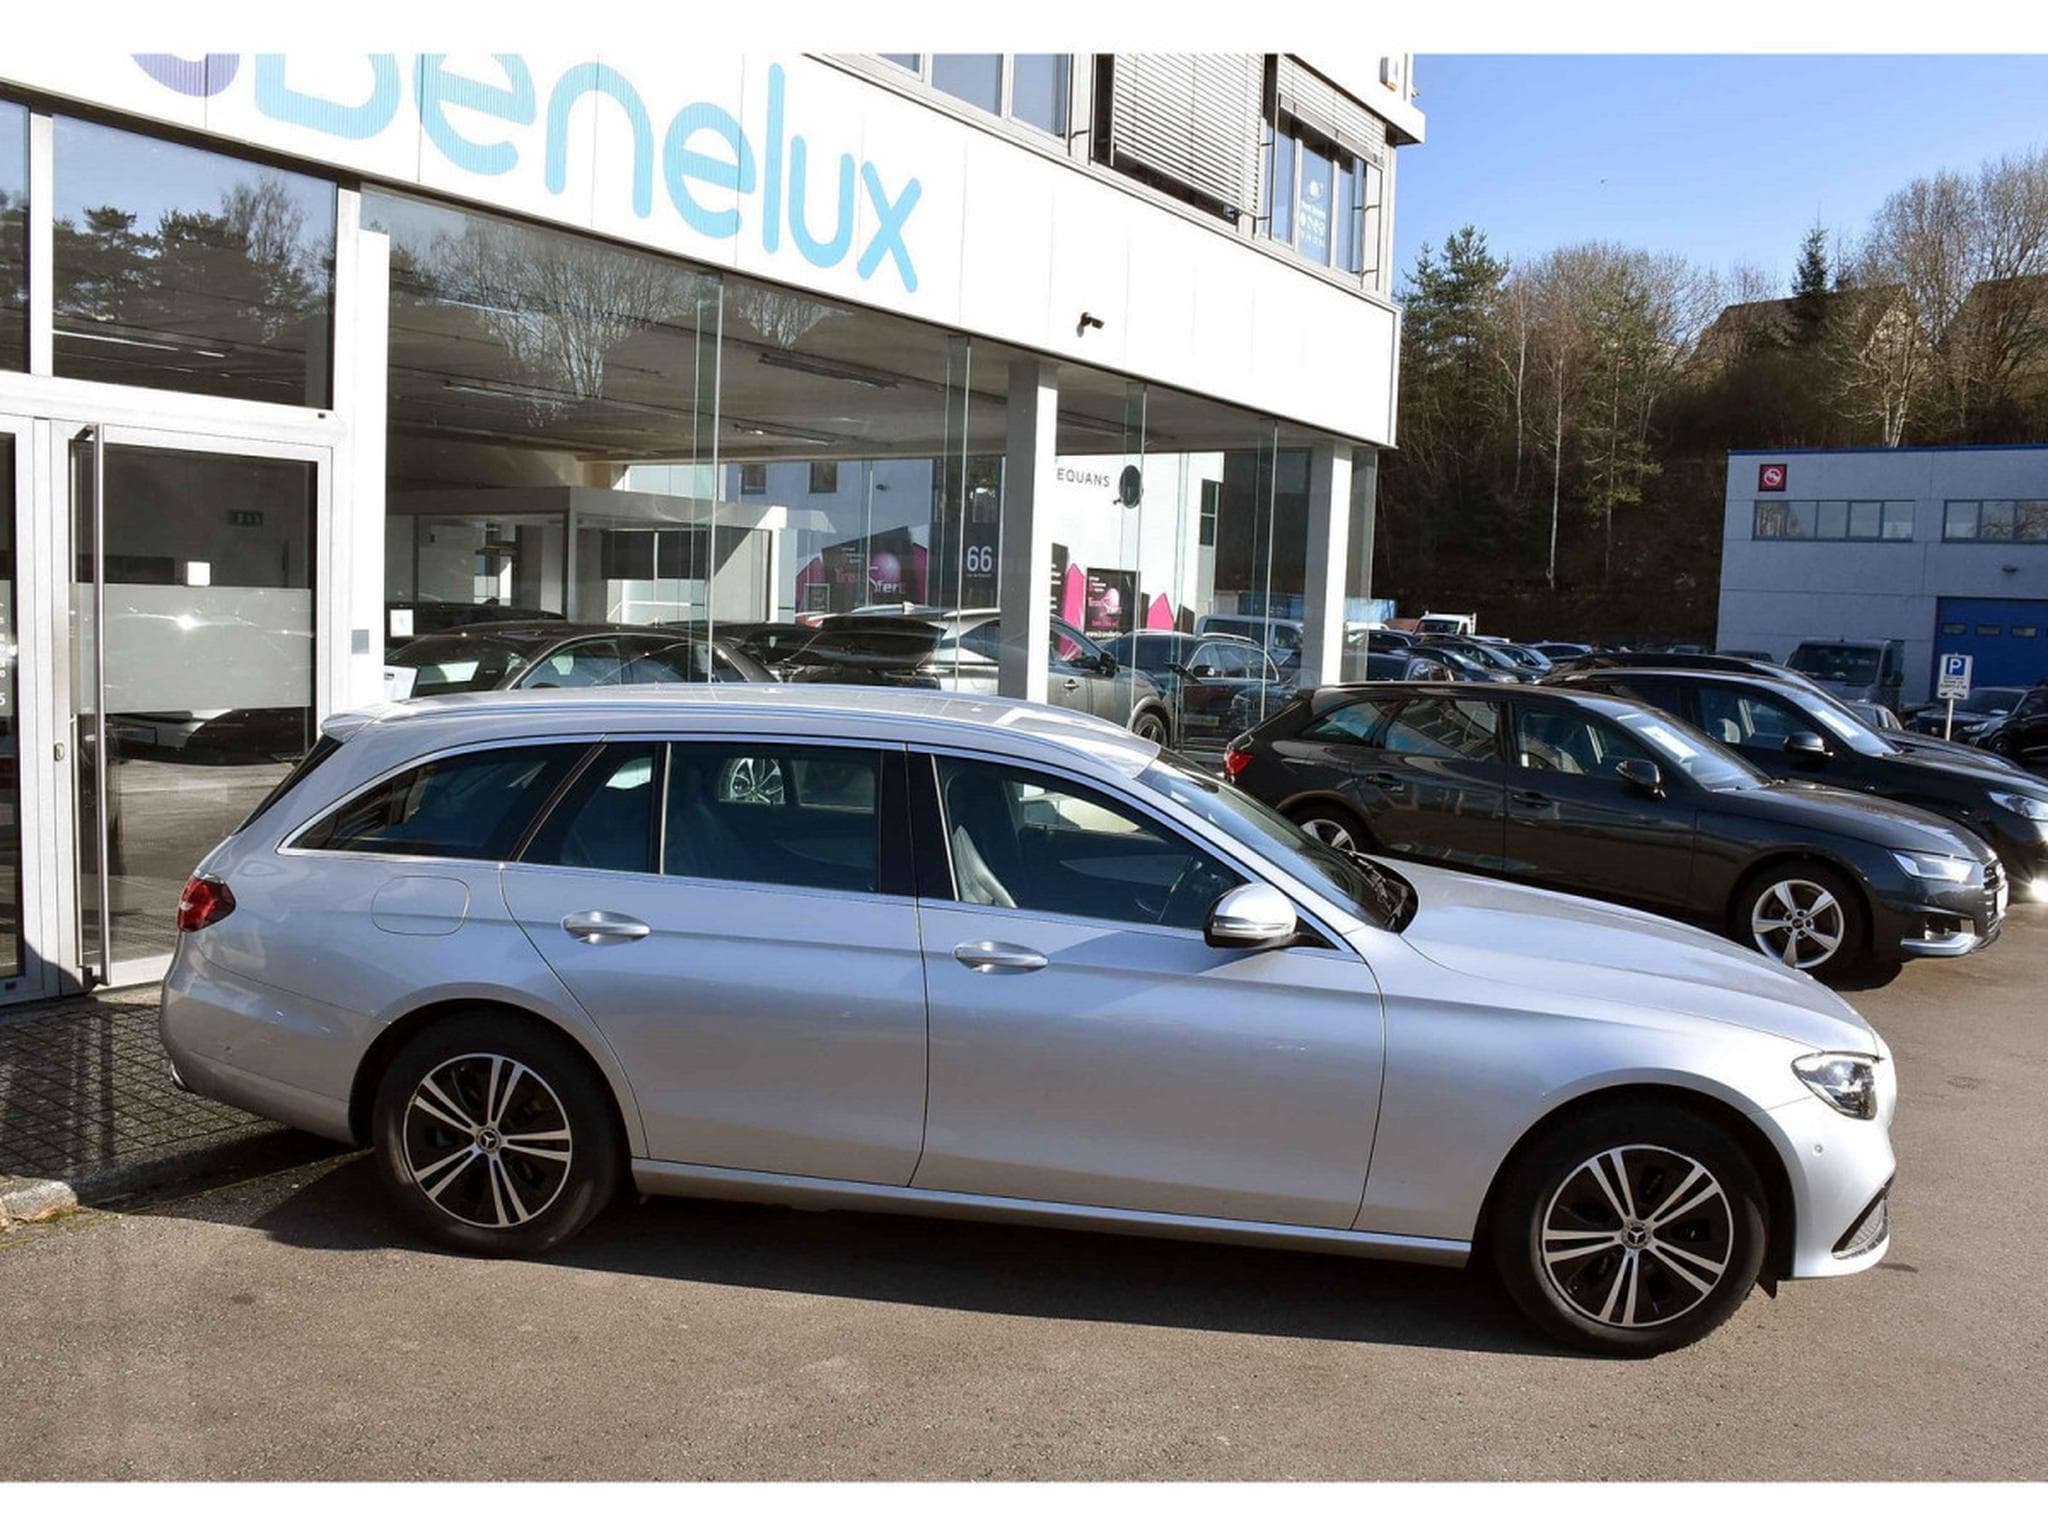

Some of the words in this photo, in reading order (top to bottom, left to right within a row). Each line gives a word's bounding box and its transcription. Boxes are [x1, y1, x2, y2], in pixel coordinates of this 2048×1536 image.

[1056, 467, 1110, 487] EQUANS
[967, 545, 993, 572] 66
[1949, 658, 1962, 674] P
